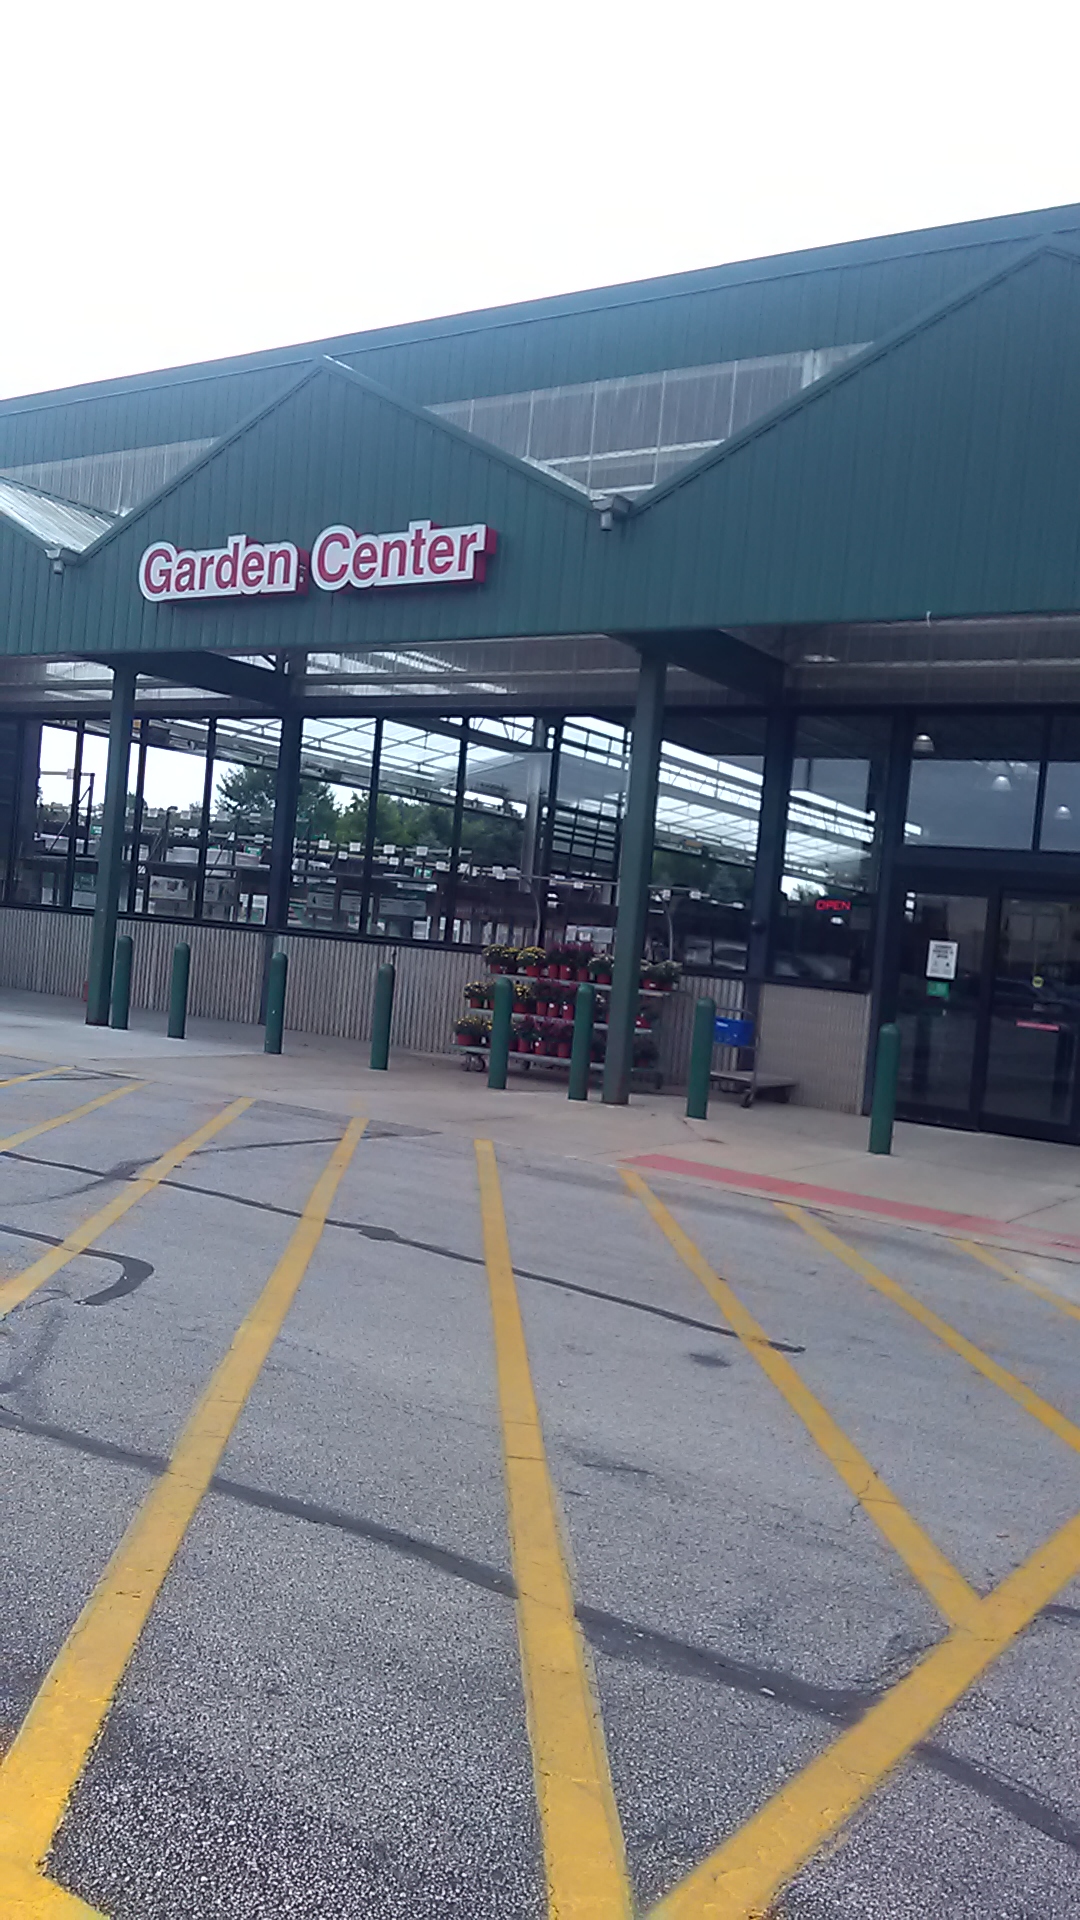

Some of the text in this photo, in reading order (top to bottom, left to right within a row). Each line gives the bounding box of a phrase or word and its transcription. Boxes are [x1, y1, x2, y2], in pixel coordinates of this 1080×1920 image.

[143, 528, 478, 594] Garden Center
[816, 900, 851, 910] OPEN
